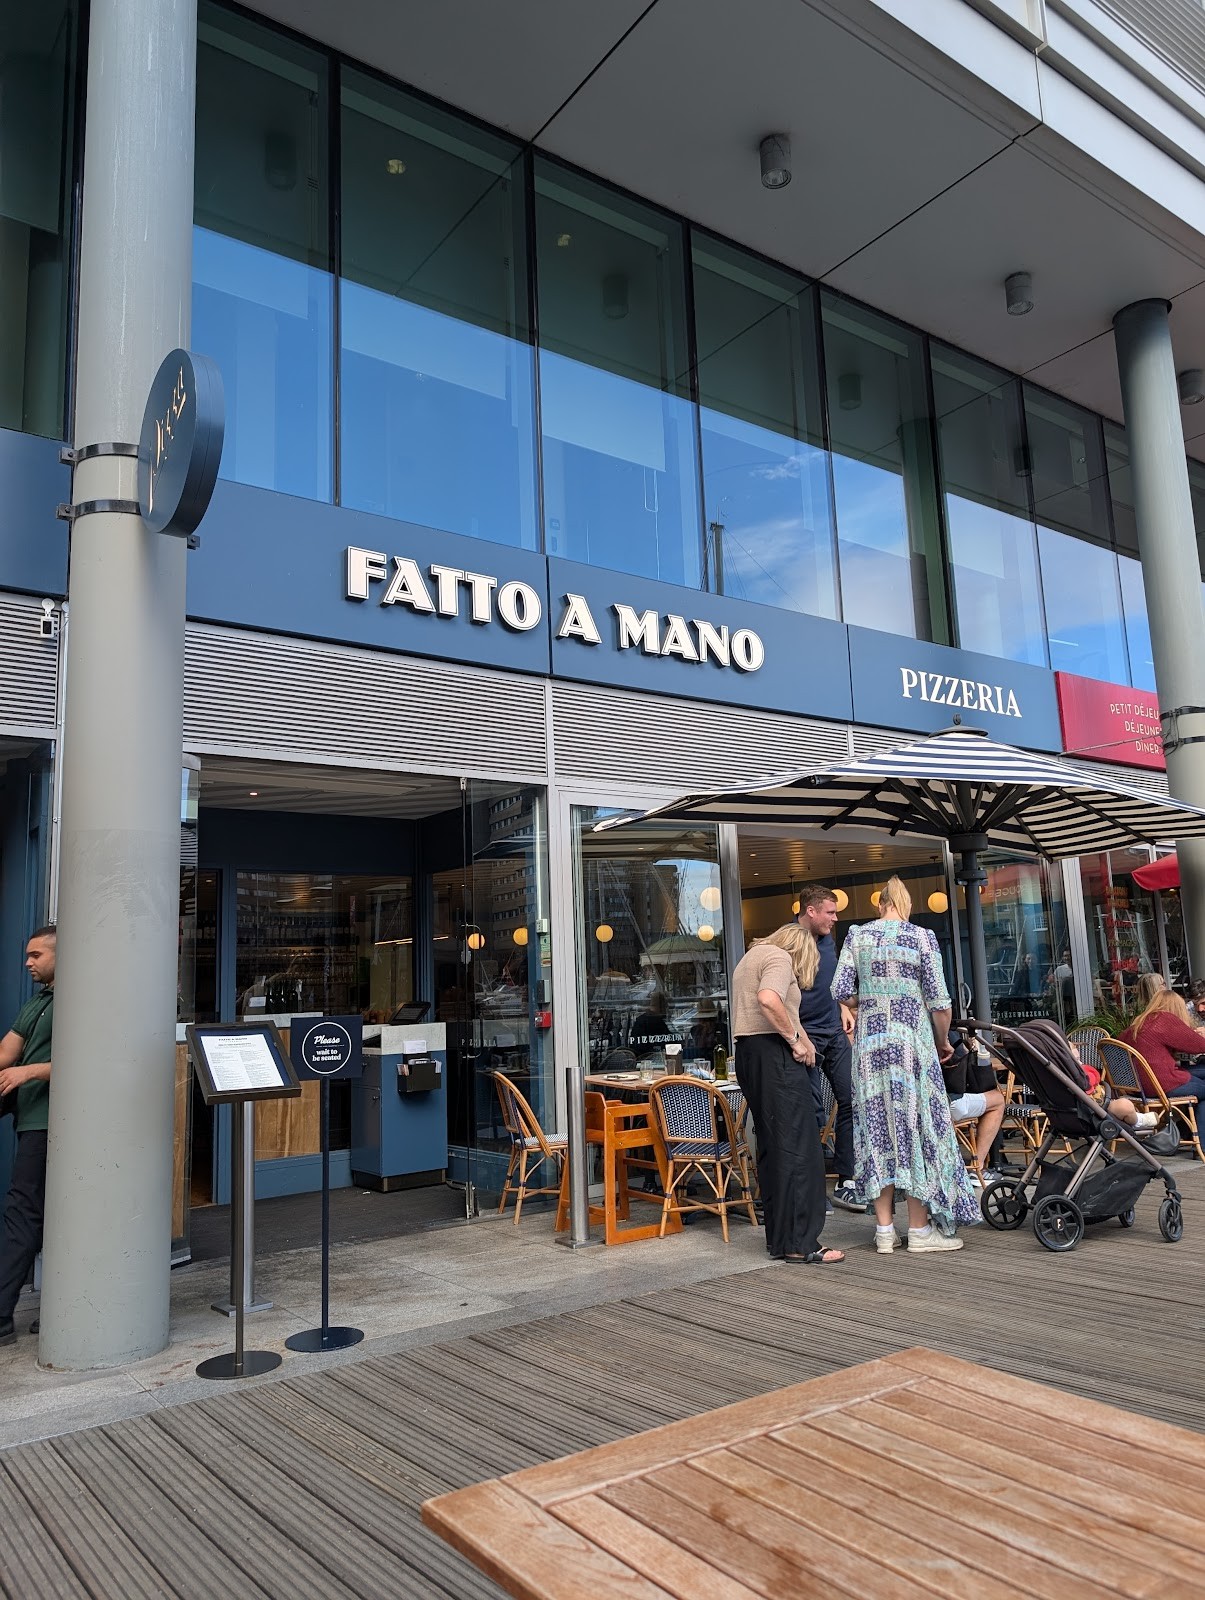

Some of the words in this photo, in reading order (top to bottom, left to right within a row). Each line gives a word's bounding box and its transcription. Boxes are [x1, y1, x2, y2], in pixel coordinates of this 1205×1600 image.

[345, 545, 542, 632] FATTO
[558, 593, 602, 645] A
[612, 603, 766, 673] MANO
[900, 667, 1022, 719] PIZZERIA
[1110, 703, 1131, 714] PETIT
[313, 1034, 341, 1045] Please
[316, 1048, 330, 1056] wait
[320, 1053, 342, 1062] seated
